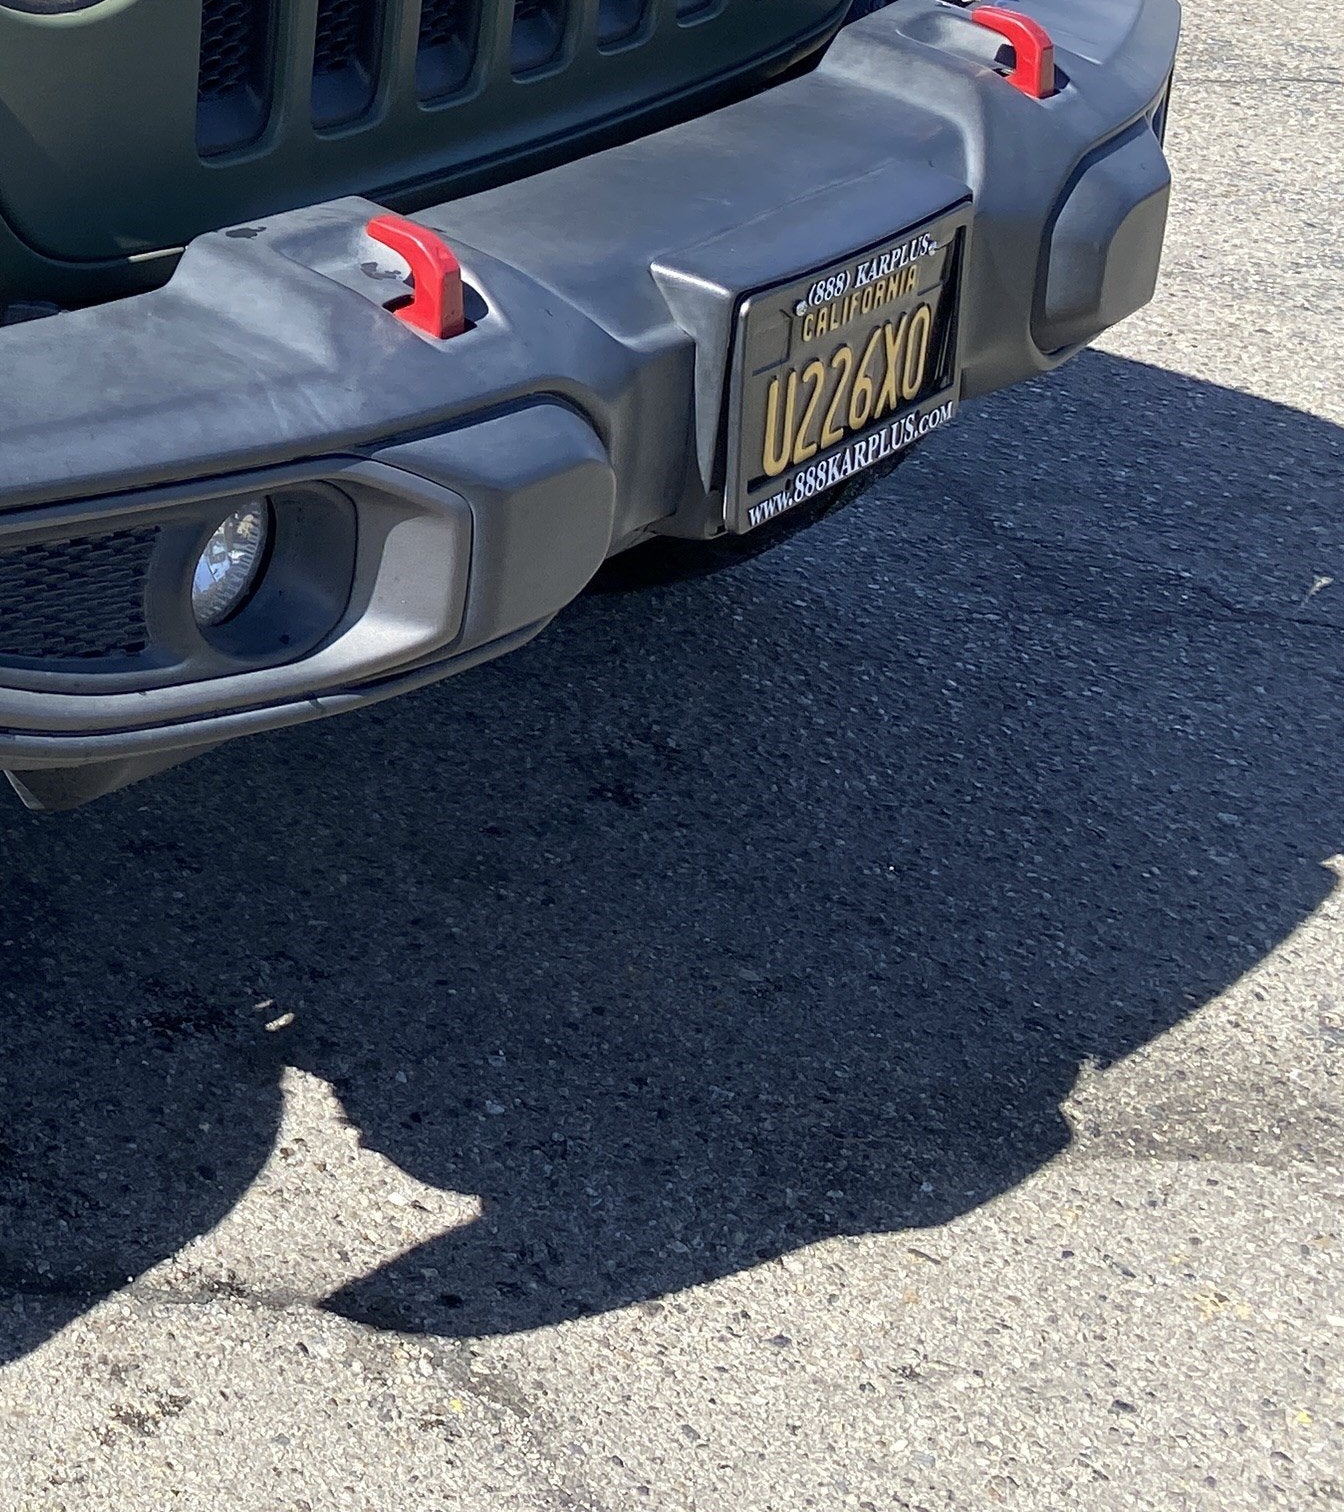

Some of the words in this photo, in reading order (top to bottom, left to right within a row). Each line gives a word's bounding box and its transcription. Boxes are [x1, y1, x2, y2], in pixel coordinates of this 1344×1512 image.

[802, 263, 919, 343] CALIFORNIA
[808, 272, 851, 308] (888)
[854, 232, 931, 290] KARPLUS
